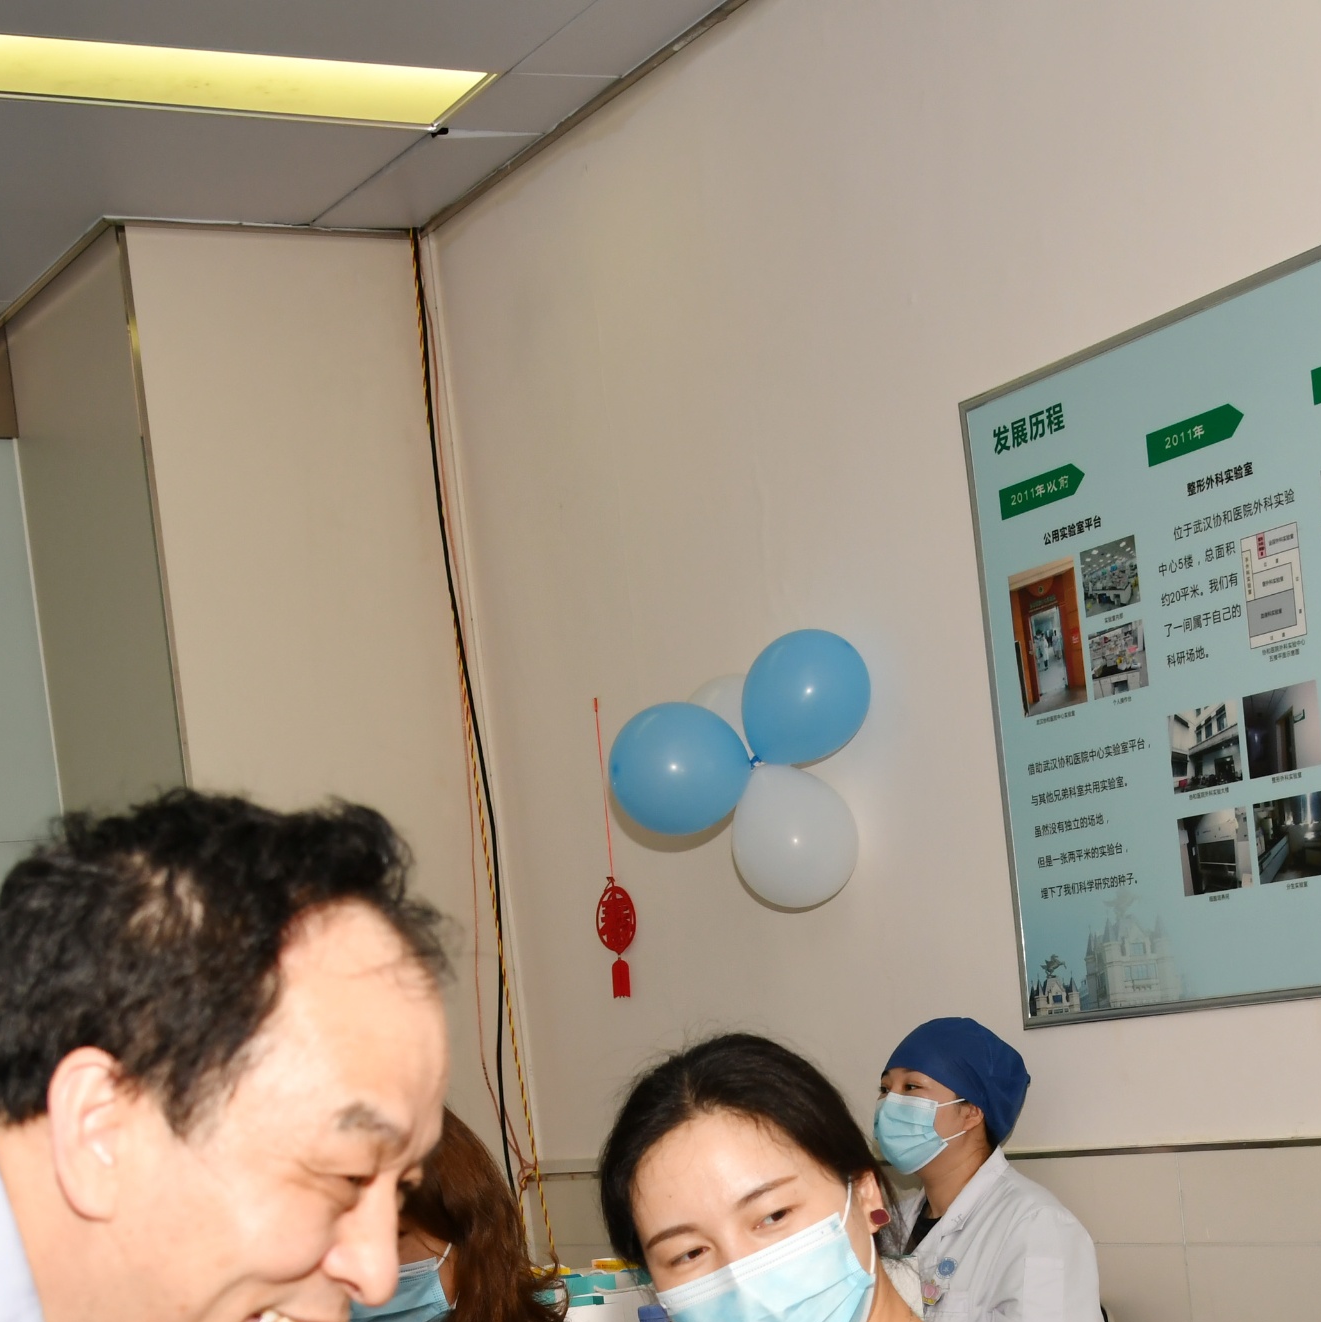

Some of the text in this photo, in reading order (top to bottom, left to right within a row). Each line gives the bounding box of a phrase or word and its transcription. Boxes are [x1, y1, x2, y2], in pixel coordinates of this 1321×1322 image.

[992, 400, 1065, 456] 发展历程
[1164, 425, 1205, 449] 2011年
[1010, 475, 1069, 506] 2011年以前
[1186, 460, 1253, 496] 整形外科实验室
[1043, 513, 1102, 546] 公用实验室平台
[1173, 487, 1295, 541] 位于武汉协和医院外科实验
[1163, 602, 1242, 638] 了一间属于自己的
